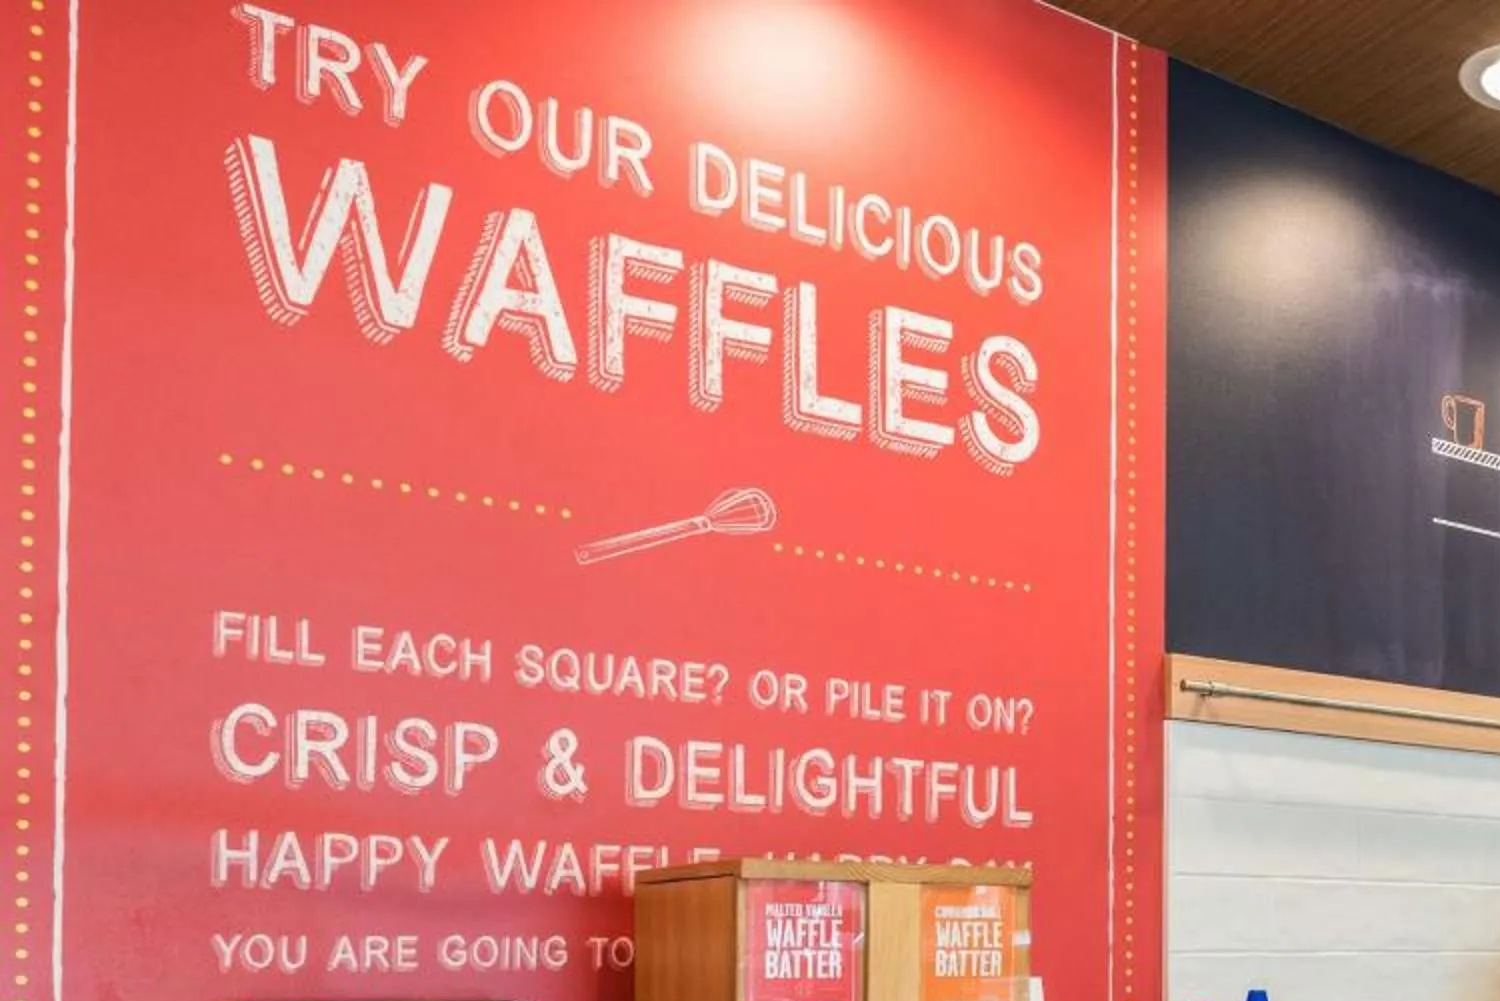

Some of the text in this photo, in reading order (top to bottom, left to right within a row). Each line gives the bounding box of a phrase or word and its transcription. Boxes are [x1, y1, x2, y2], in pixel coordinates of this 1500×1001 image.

[234, 2, 1044, 304] TRY OUR DELICIOUS
[225, 133, 1041, 478] WAFFLES
[212, 610, 1034, 734] FILL EACH SQUARE? OR PILE IT ON?
[212, 701, 1034, 828] CRISP & DELIGHTFUL
[212, 830, 449, 893] HAPPY
[214, 933, 635, 973] YOU ARE GOING TO
[766, 918, 844, 948] WAFFLE
[935, 920, 1004, 948] WAFFLE
[765, 949, 843, 979] BATTER
[935, 949, 1002, 977] BATTER
